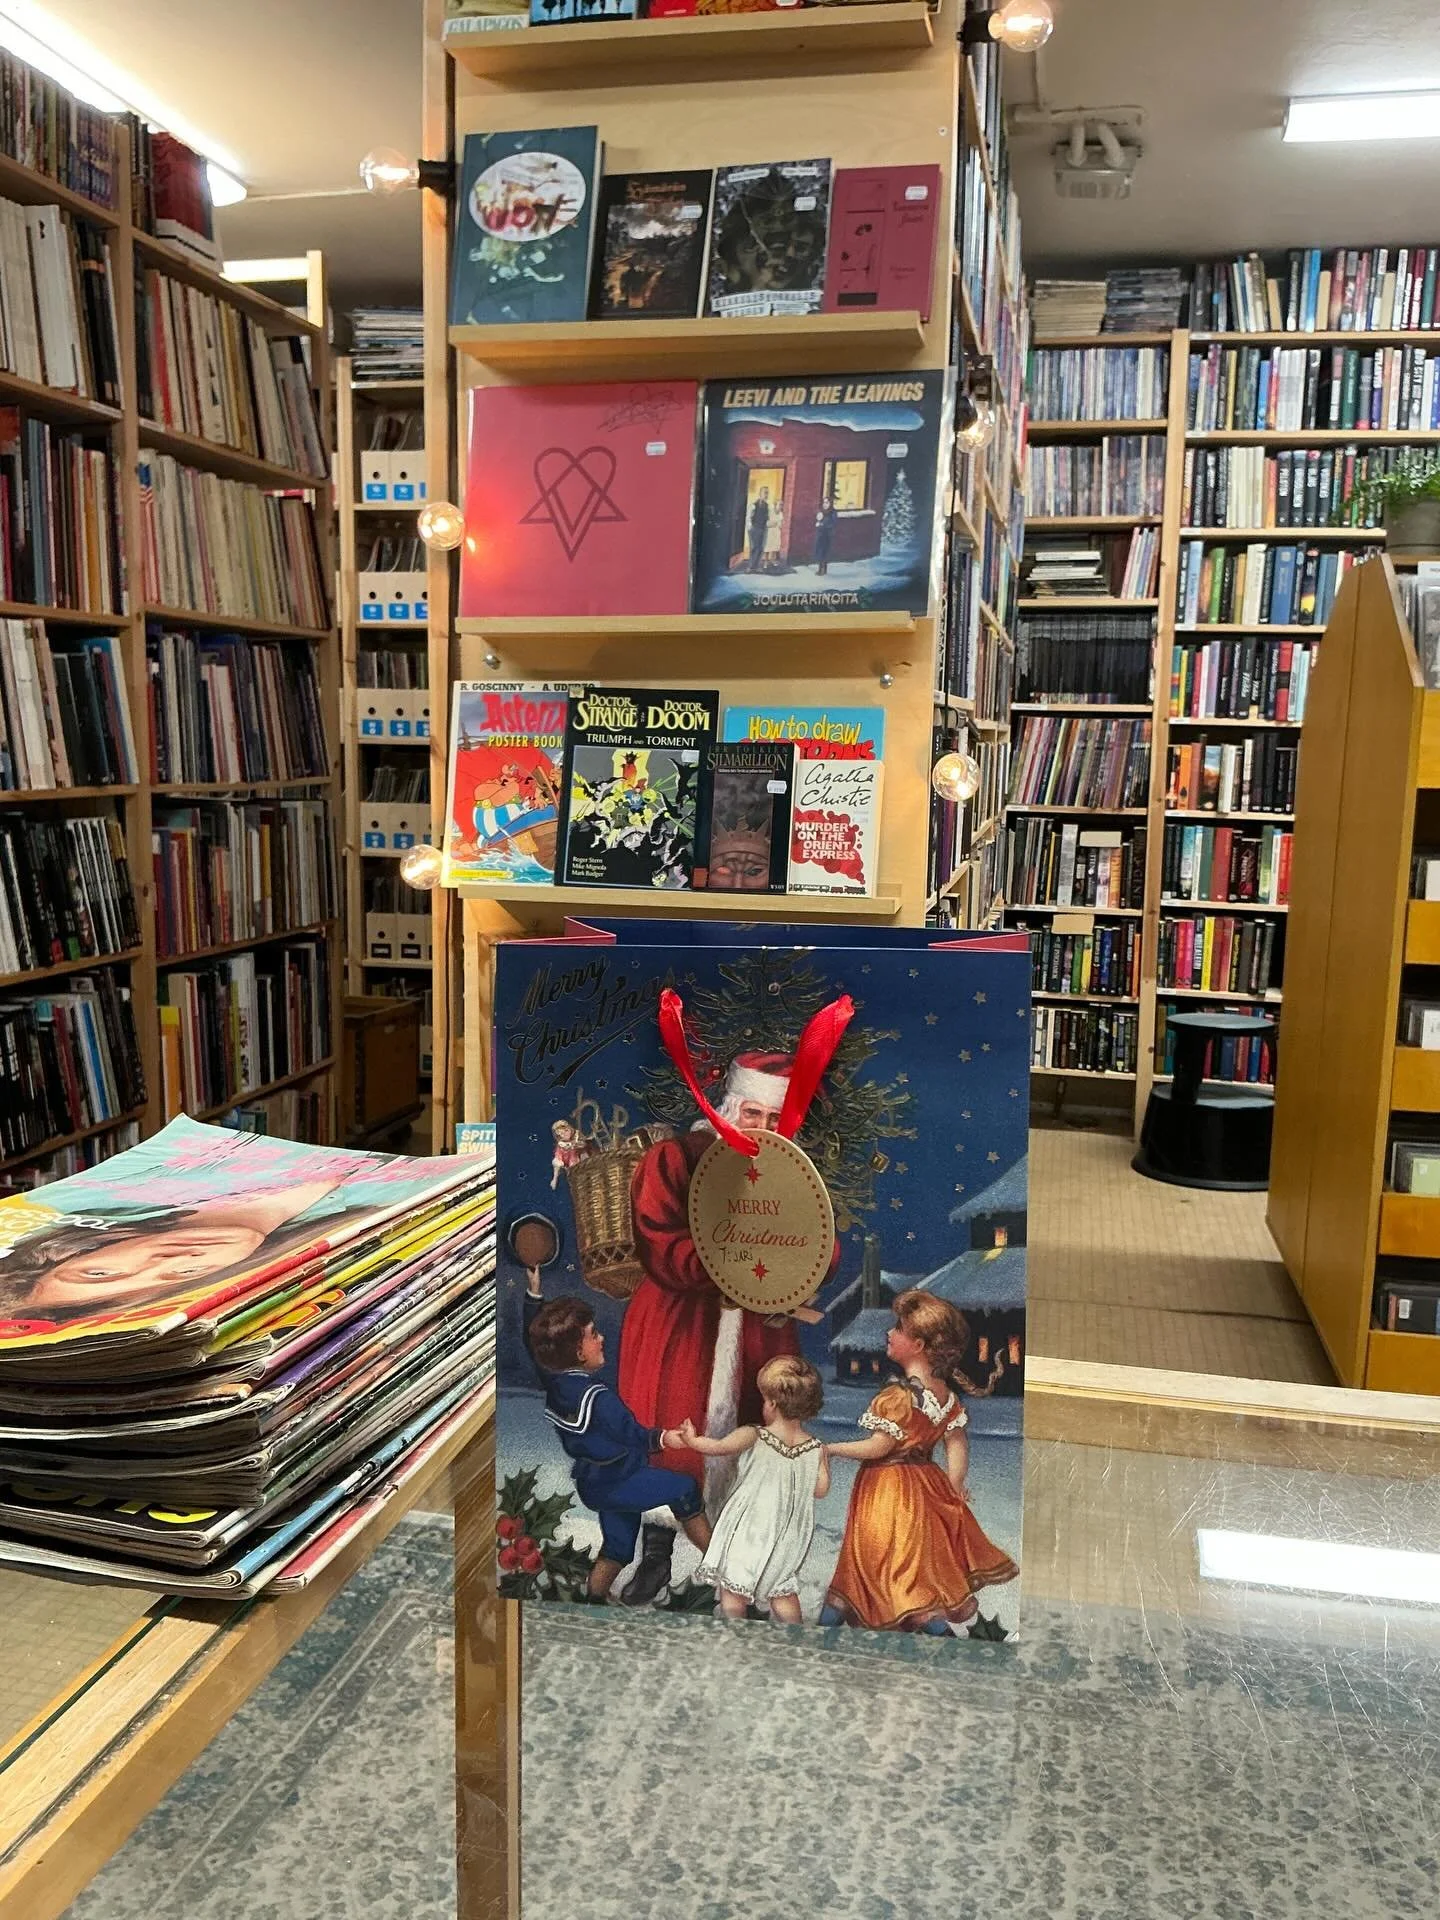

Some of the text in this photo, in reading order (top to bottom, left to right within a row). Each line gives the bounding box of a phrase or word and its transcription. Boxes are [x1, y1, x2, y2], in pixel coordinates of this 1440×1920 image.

[722, 382, 925, 408] LEEVI AND THE LEAVINGS
[753, 592, 859, 606] JOULUTARINOITA
[472, 683, 525, 691] GOSCINNY
[590, 694, 638, 707] DOCTOR
[664, 700, 710, 712] DOCTOR
[573, 700, 638, 731] STRANGE
[645, 705, 710, 731] DOOM
[787, 714, 808, 740] to
[812, 714, 861, 745] draw
[488, 735, 564, 748] POSTER BOOK
[586, 733, 632, 745] TRIUMPH
[645, 736, 696, 747] TORMENT
[706, 752, 788, 770] SILMARILLION
[805, 763, 874, 789] Agatha
[800, 786, 872, 807] Christie
[795, 822, 849, 832] MURDER
[797, 831, 845, 841] ON THE
[804, 841, 851, 850] ORIENT
[802, 850, 855, 860] EXPRESS
[505, 953, 611, 1029] Merry
[728, 1199, 781, 1216] MERRY
[712, 1219, 808, 1247] Christmas
